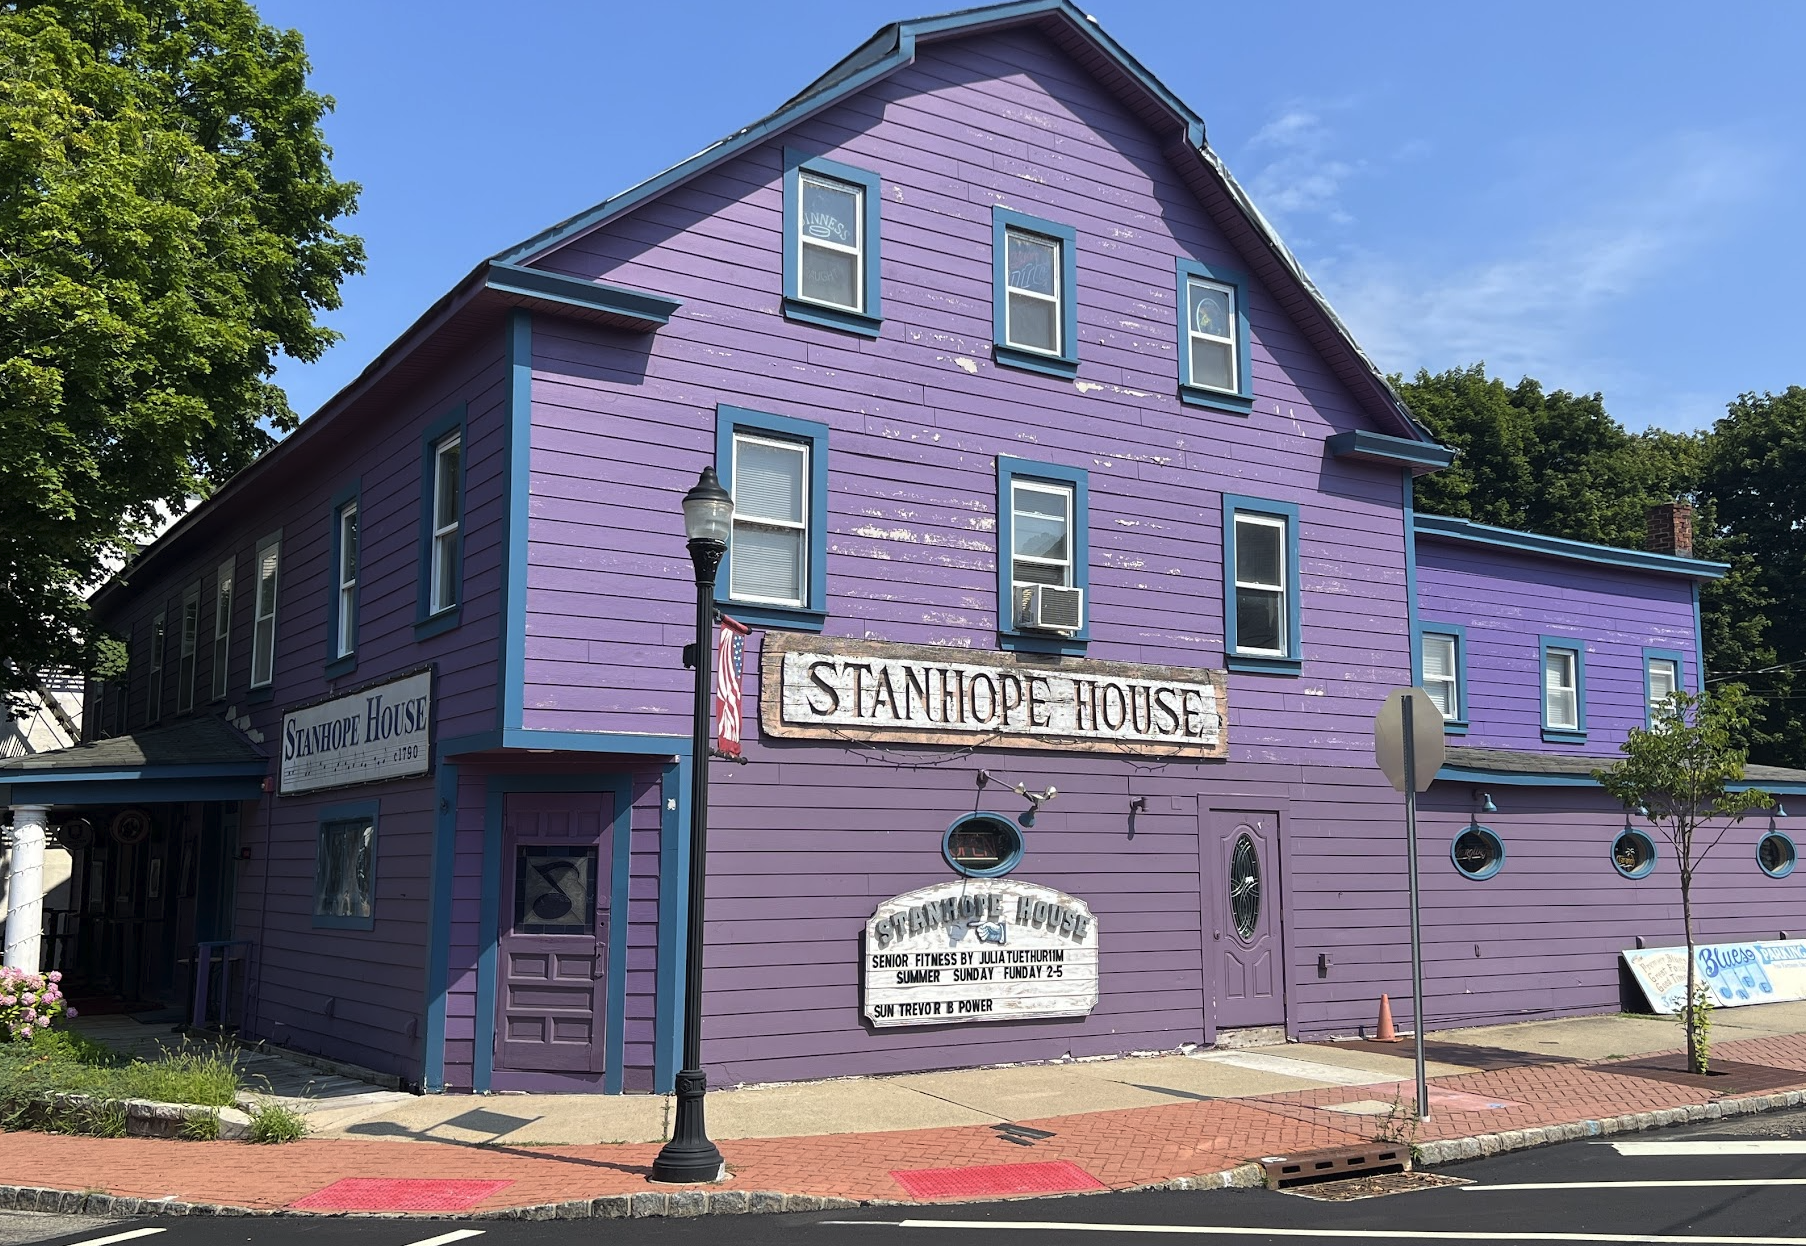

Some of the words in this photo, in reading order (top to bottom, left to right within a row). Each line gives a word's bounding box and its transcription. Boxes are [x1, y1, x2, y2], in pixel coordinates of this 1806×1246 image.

[801, 212, 850, 241] INNESS
[806, 661, 1051, 728] STANHOPE
[1073, 680, 1203, 739] HOUSE
[285, 717, 360, 762] STANHOPE
[364, 695, 428, 743] HOUSE
[875, 894, 1003, 946] STANHOPE
[1015, 896, 1091, 942] HOUSE
[872, 954, 909, 969] SENIOR
[915, 952, 957, 967] FITNESS
[960, 951, 974, 966] BY
[979, 951, 1005, 965] JULIA
[896, 970, 941, 985] SUMMER
[953, 967, 994, 982] SUNDAY
[1004, 966, 1042, 980] FUNDAY
[1046, 965, 1064, 978] 2-5
[1699, 947, 1756, 978] Blues
[874, 1003, 895, 1018] SUN
[899, 1001, 941, 1017] TREVOR
[946, 1000, 955, 1014] B
[958, 998, 993, 1013] POWER
